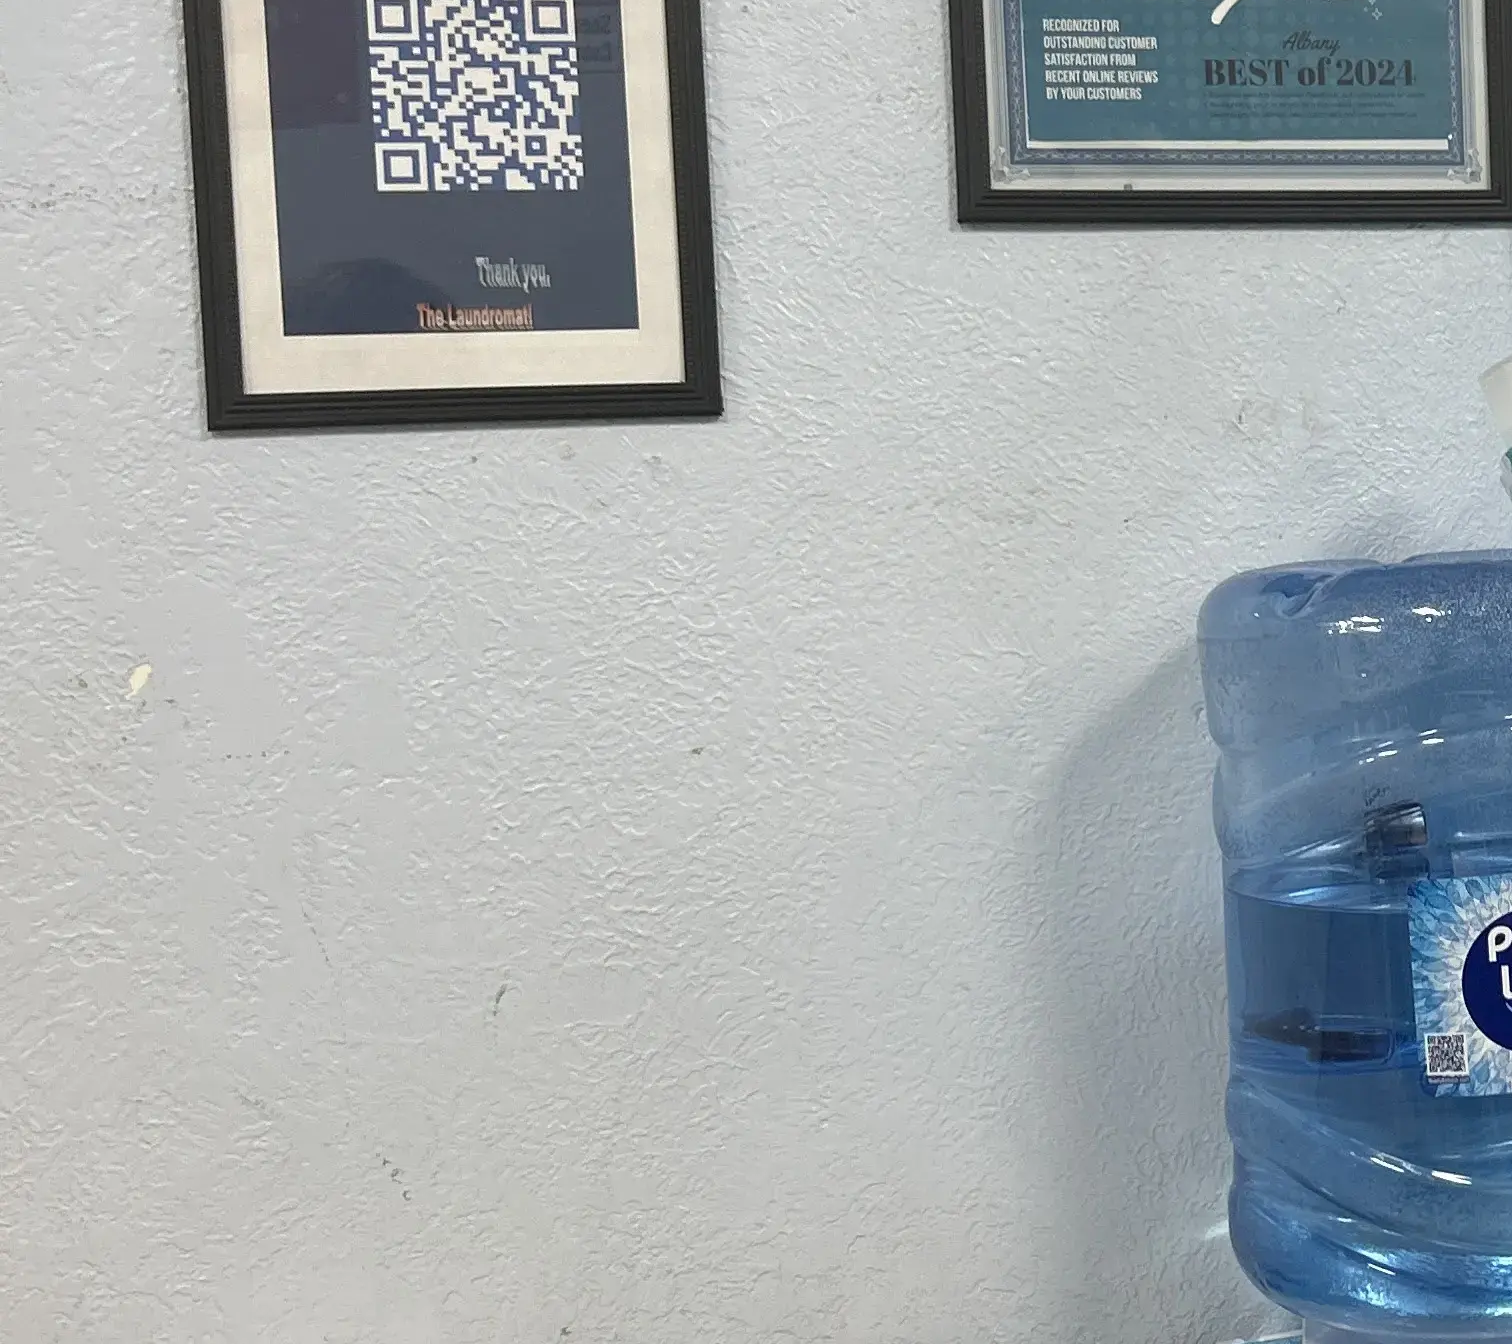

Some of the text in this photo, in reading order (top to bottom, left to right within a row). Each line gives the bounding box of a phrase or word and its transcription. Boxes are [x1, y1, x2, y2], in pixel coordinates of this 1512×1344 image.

[1042, 19, 1120, 32] RECOGNIZED FOR
[1043, 36, 1157, 50] OUTSTANDING CUSTOMER
[1281, 30, 1341, 56] Albany
[1044, 53, 1136, 66] SATISFACTION FROM
[1045, 70, 1159, 83] RECENT ONLINE REVIEWS
[1203, 57, 1416, 87] BEST of 2024
[1046, 87, 1142, 100] BY YOUR CUSTOMERS
[475, 256, 521, 288] Thank
[416, 303, 534, 331] The Laundromat!
